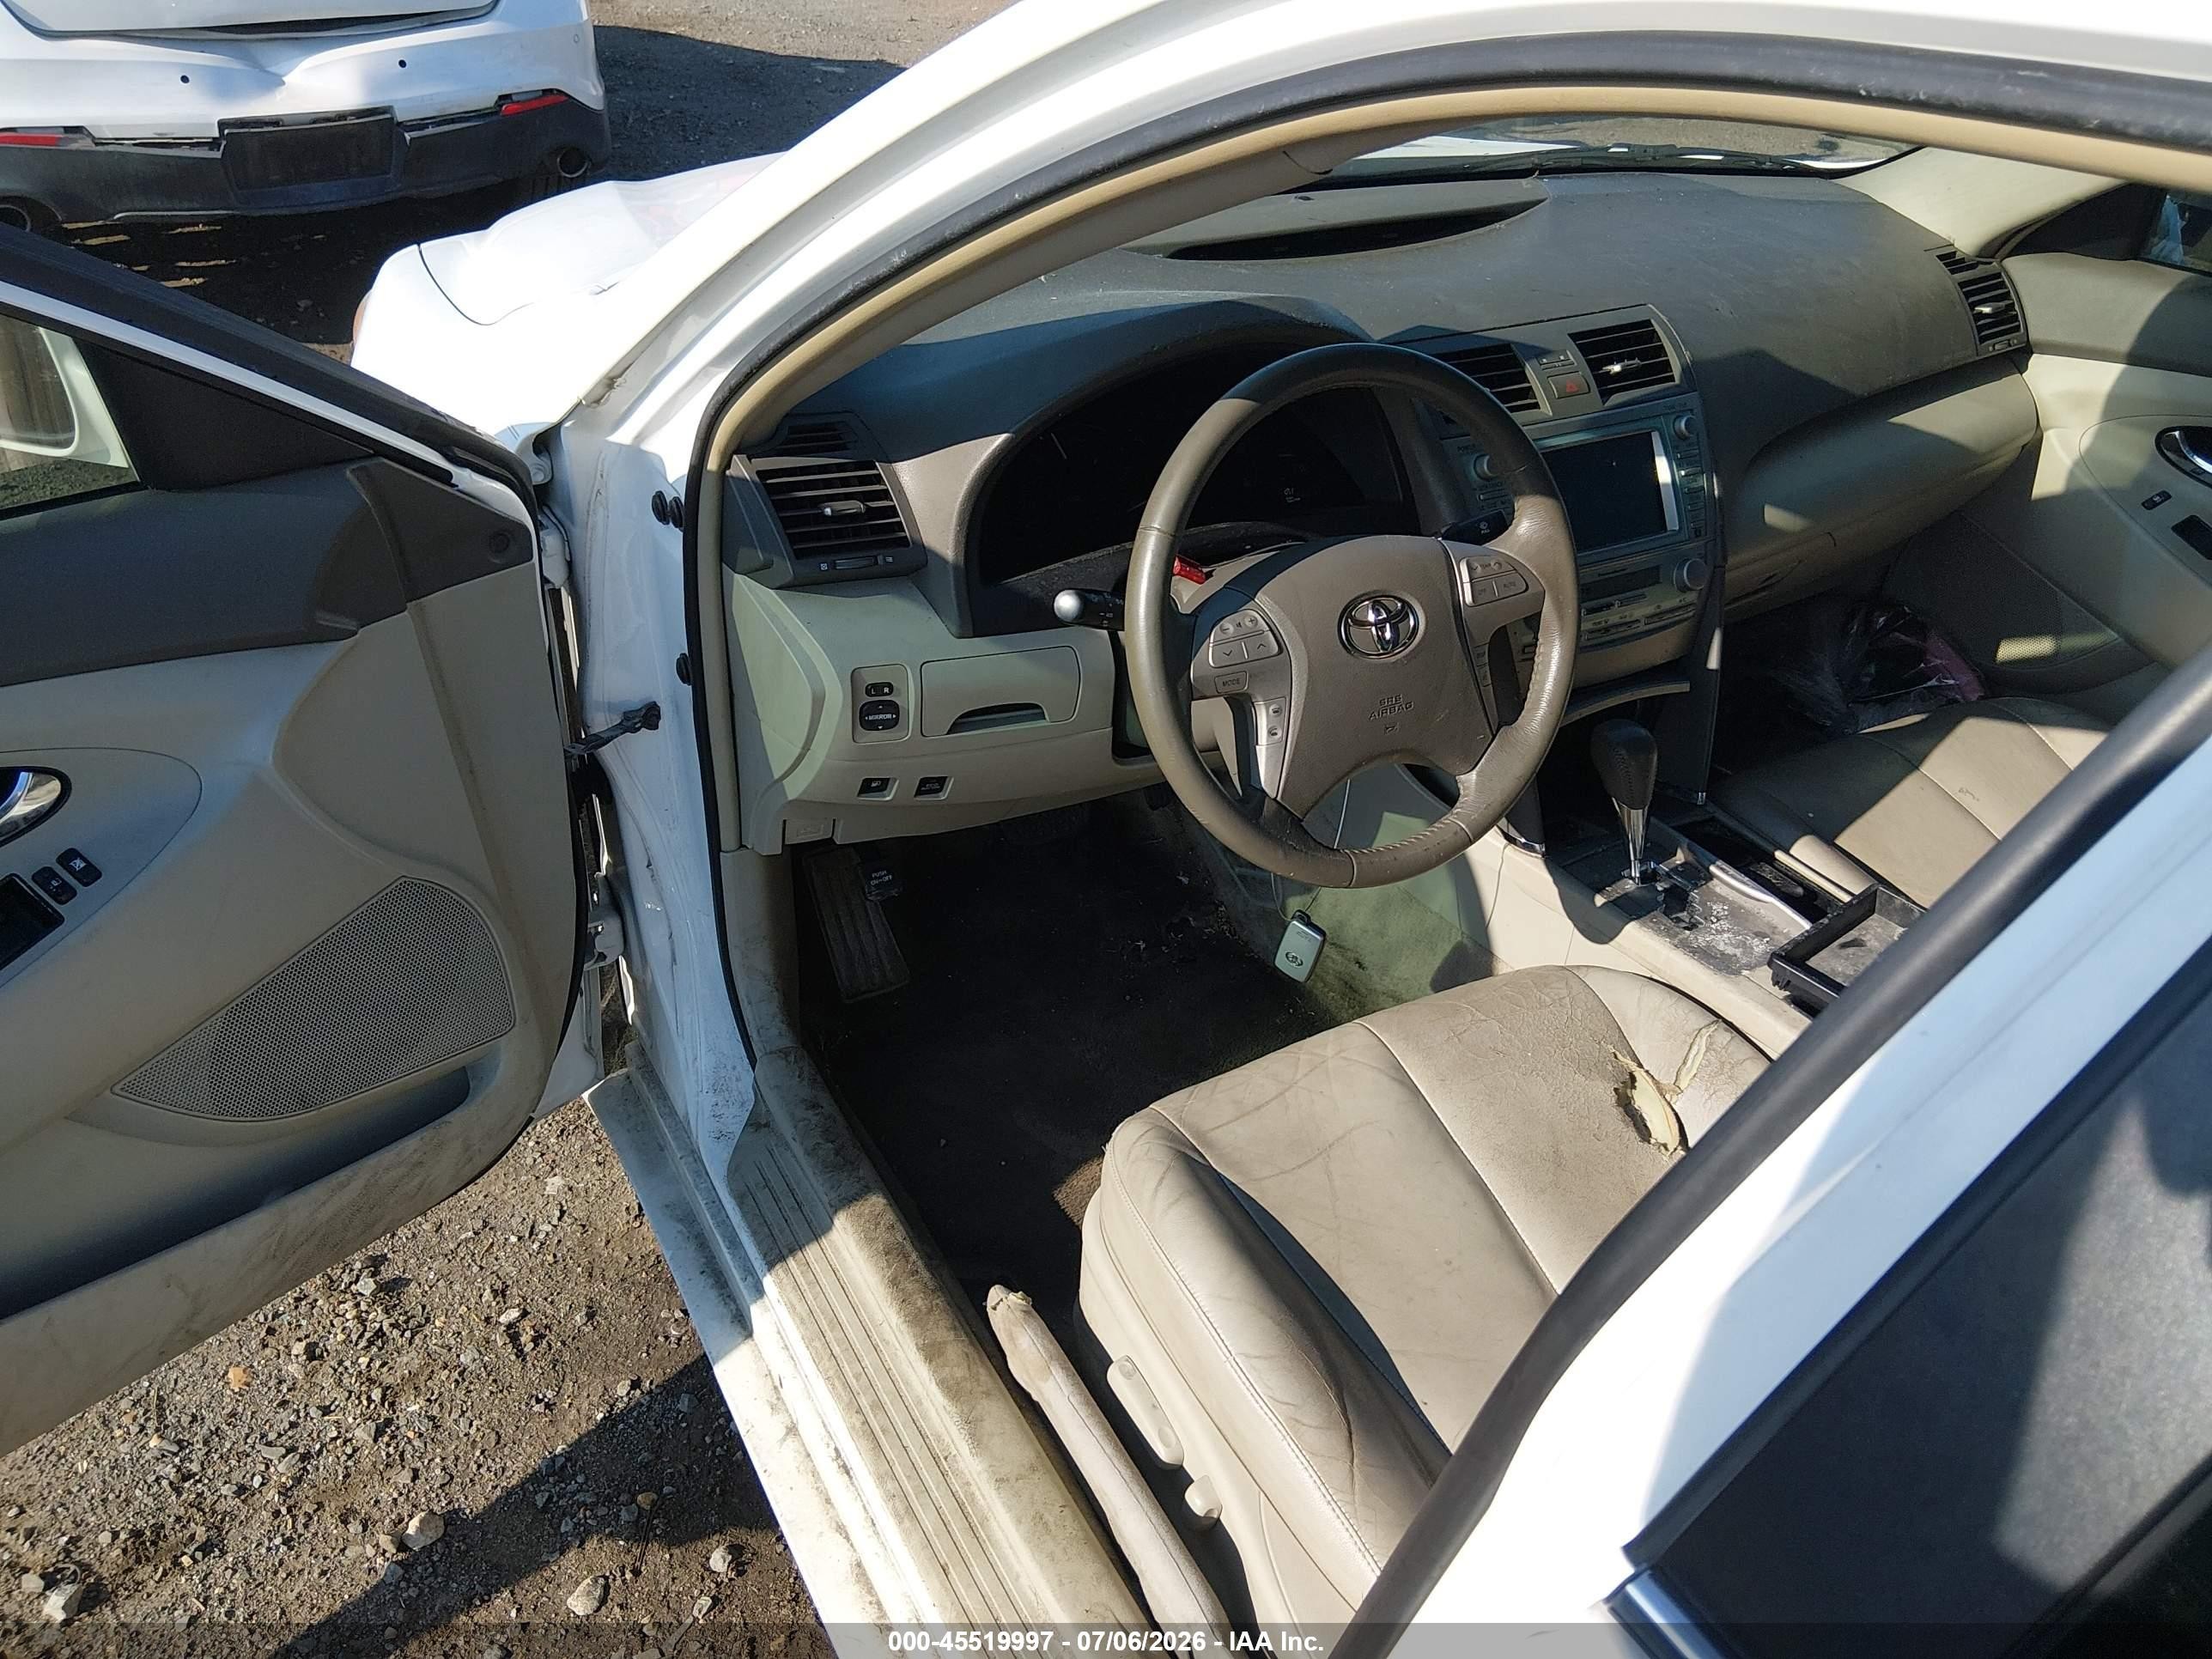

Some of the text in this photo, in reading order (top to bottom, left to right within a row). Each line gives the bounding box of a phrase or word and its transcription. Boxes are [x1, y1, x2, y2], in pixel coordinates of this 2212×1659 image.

[1222, 678, 1241, 687] MODE
[1379, 694, 1403, 707] SRS
[1368, 701, 1414, 720] AIRBAG
